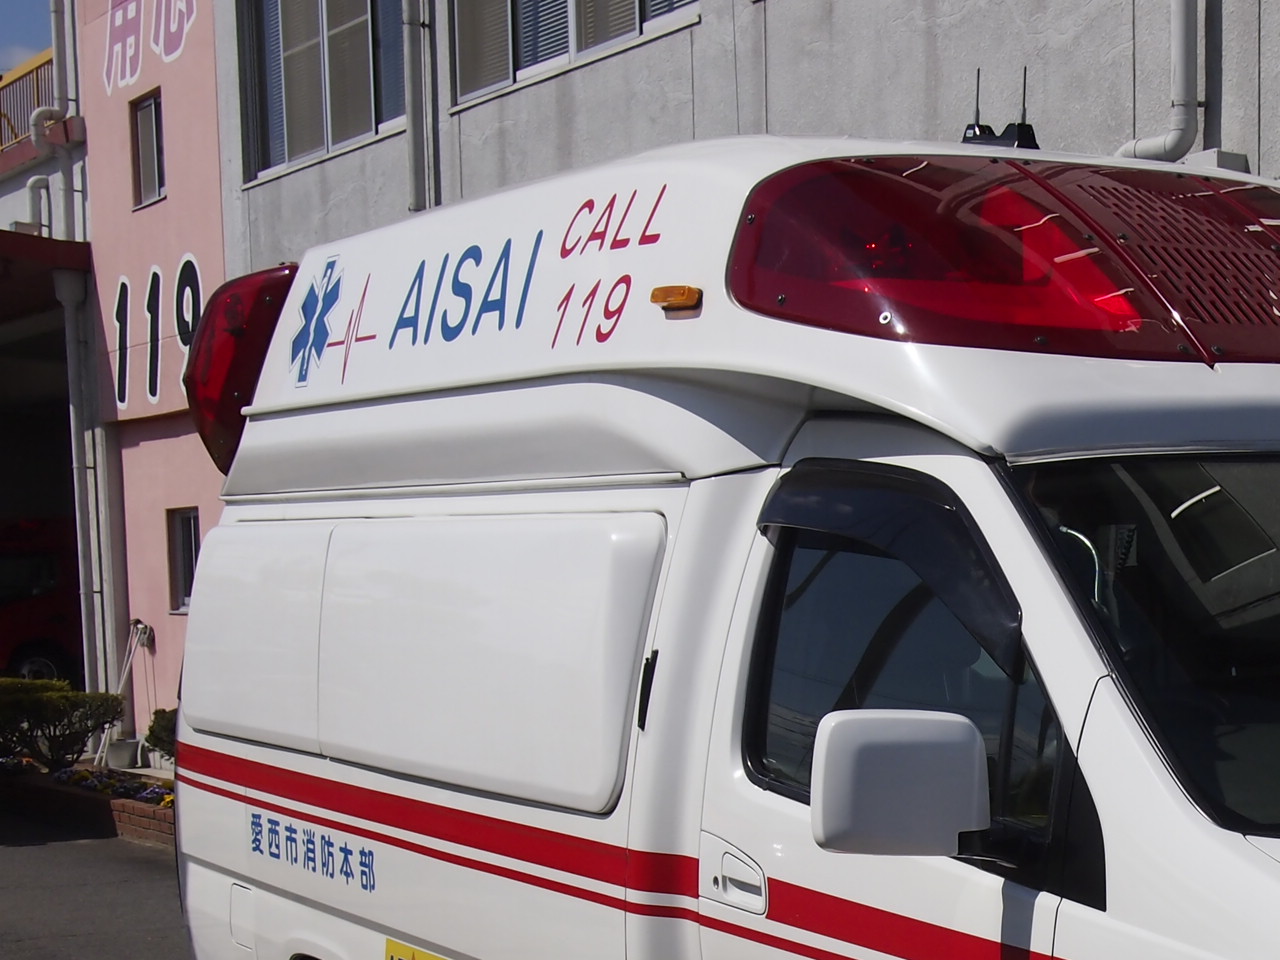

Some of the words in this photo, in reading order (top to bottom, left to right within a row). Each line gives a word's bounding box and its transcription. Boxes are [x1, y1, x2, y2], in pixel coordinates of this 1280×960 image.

[560, 183, 667, 259] CALL
[388, 229, 543, 350] AISAI
[551, 274, 632, 349] 119
[251, 813, 376, 893] 愛西市消防本部
